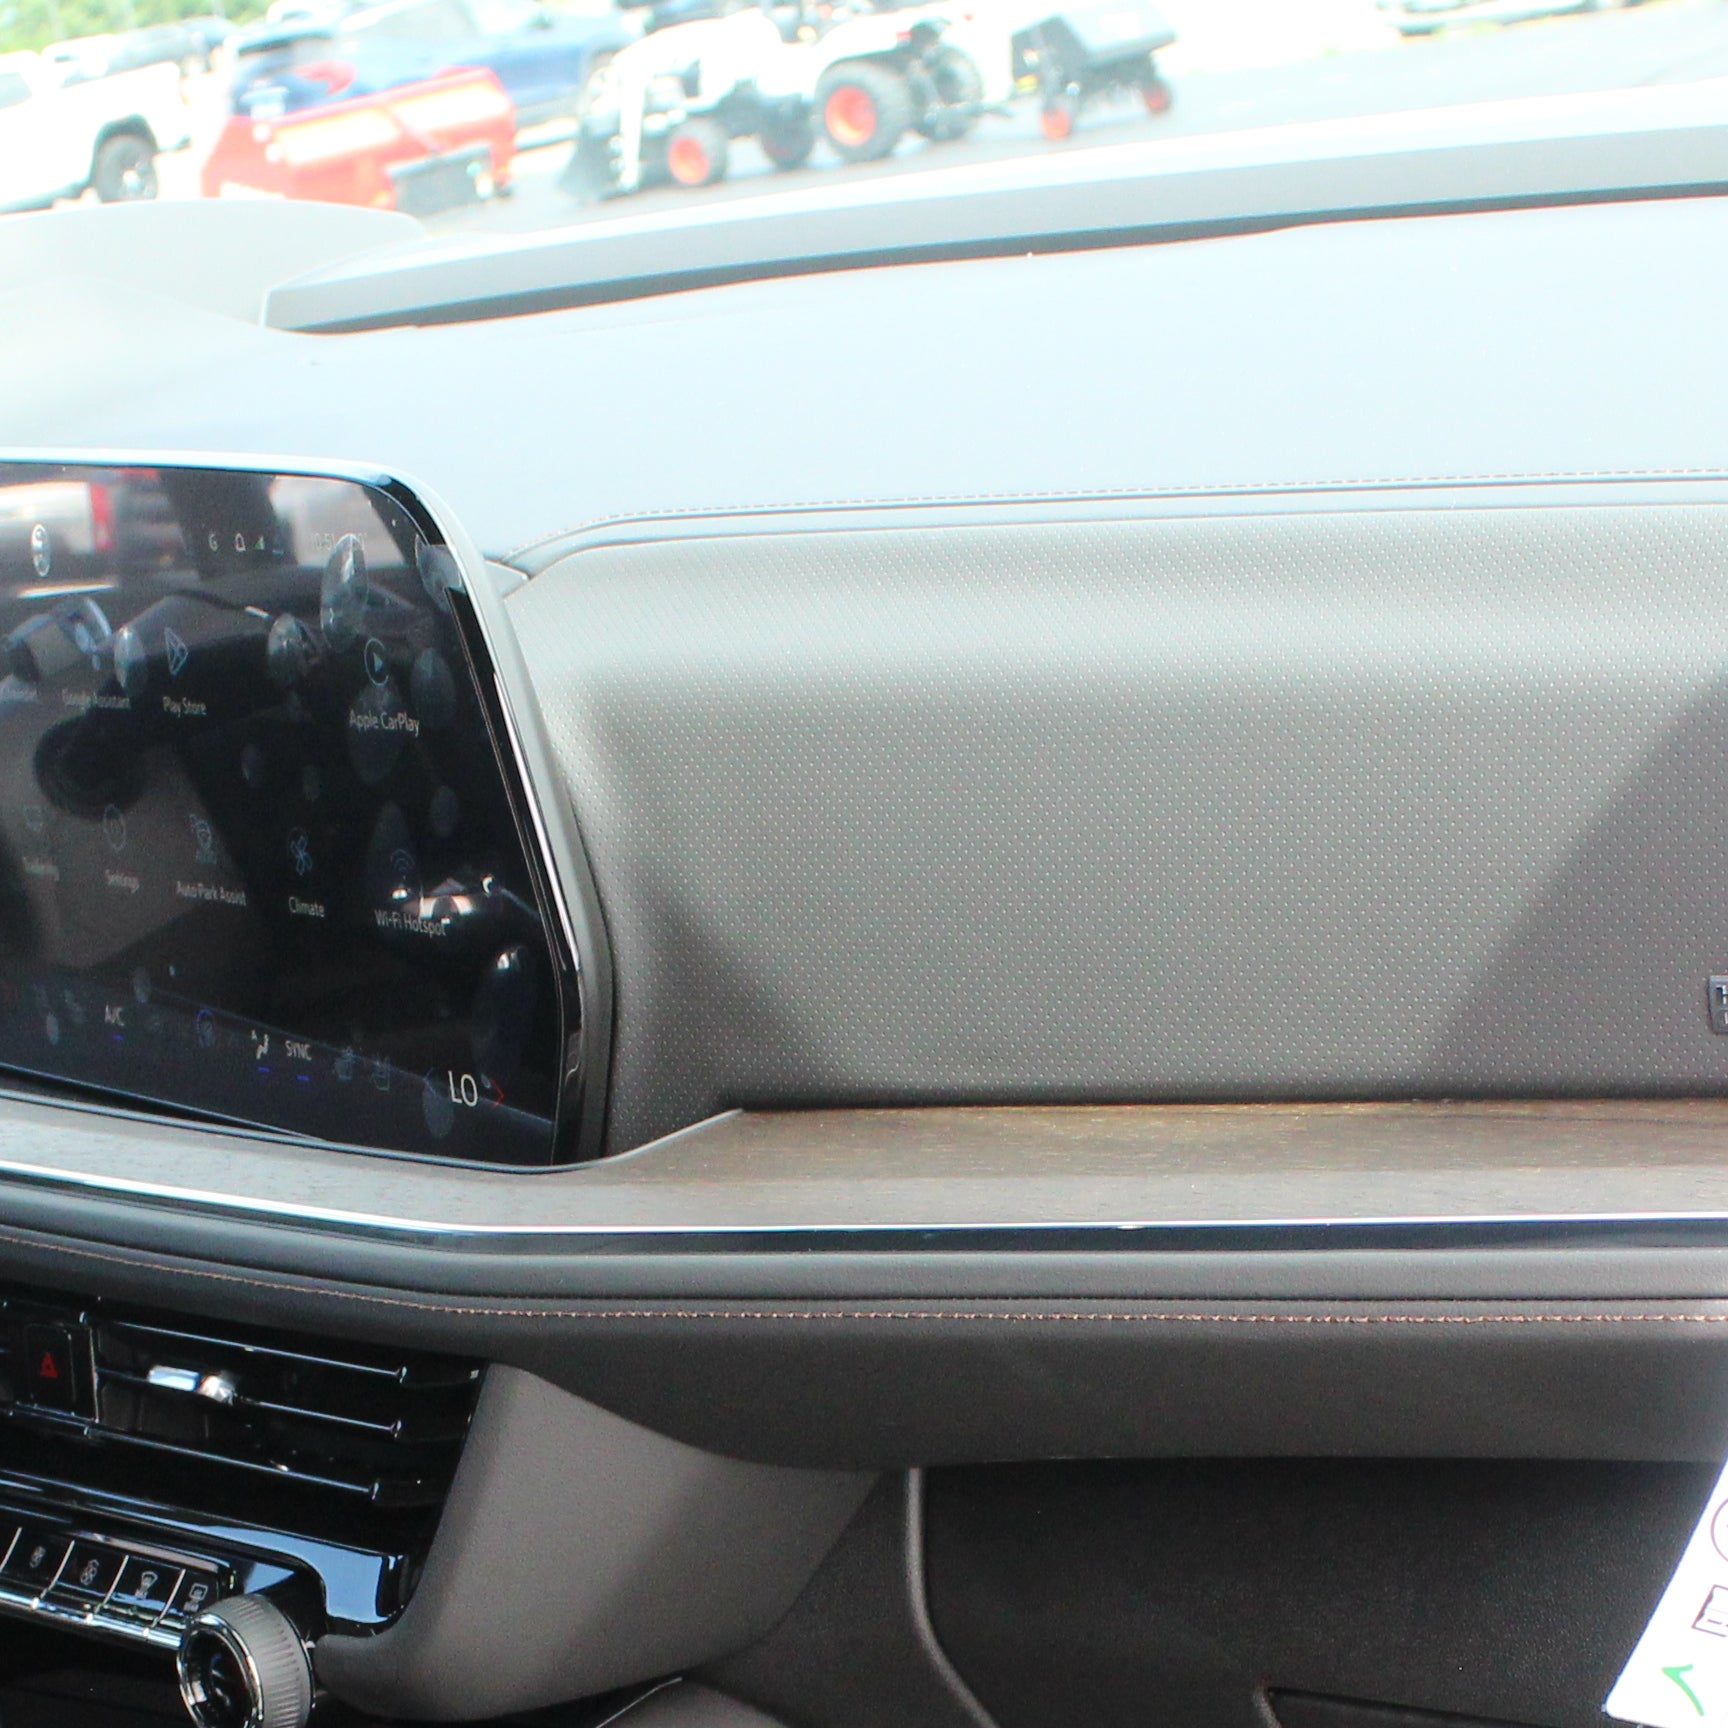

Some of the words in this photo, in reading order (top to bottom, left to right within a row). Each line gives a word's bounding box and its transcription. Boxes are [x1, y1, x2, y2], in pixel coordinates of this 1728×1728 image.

[163, 696, 182, 718] Play
[183, 698, 208, 716] Store
[349, 709, 379, 734] Apple
[381, 711, 420, 737] CarPlay
[288, 896, 325, 918] Climate
[373, 908, 403, 927] Wi-Fi
[404, 910, 447, 938] Hotspot
[285, 1040, 313, 1061] SYNC
[448, 1070, 478, 1107] LO
